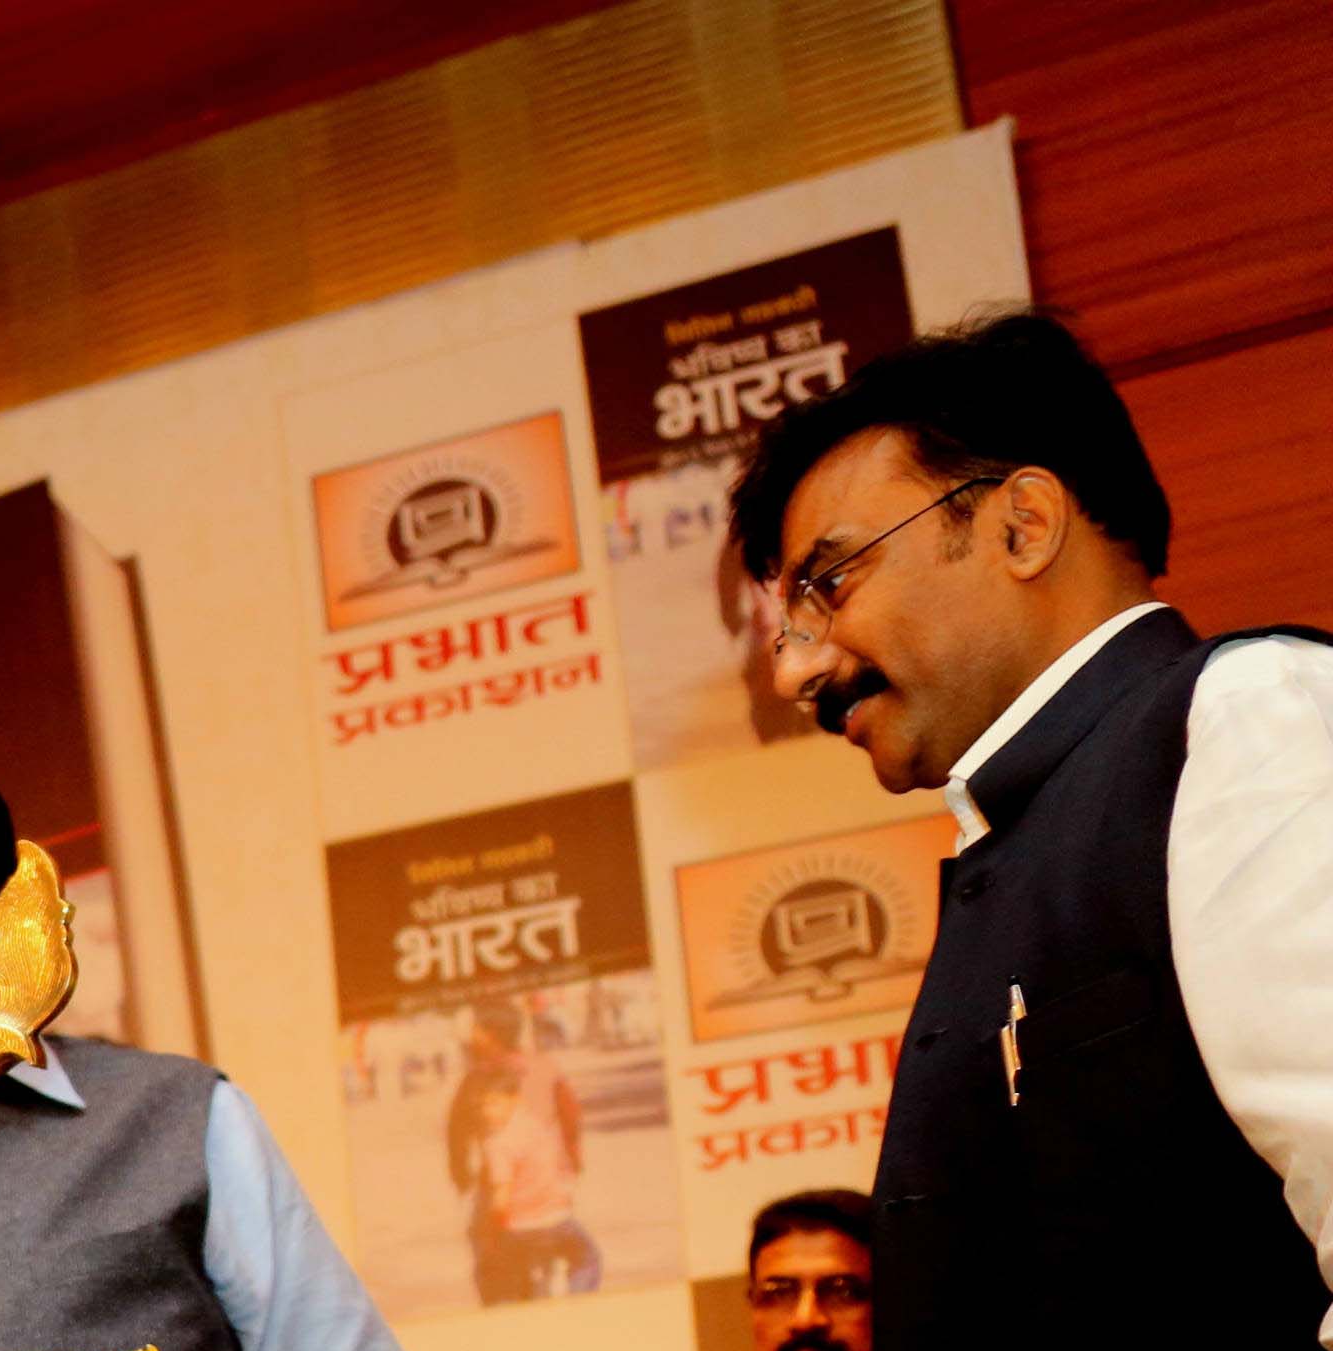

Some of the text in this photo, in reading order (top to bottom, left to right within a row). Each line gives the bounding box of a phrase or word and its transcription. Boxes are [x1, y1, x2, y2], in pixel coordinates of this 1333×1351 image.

[653, 340, 849, 440] भारत
[323, 589, 595, 697] प्रभात
[329, 652, 603, 746] प्रकाशन
[394, 894, 583, 983] भारत
